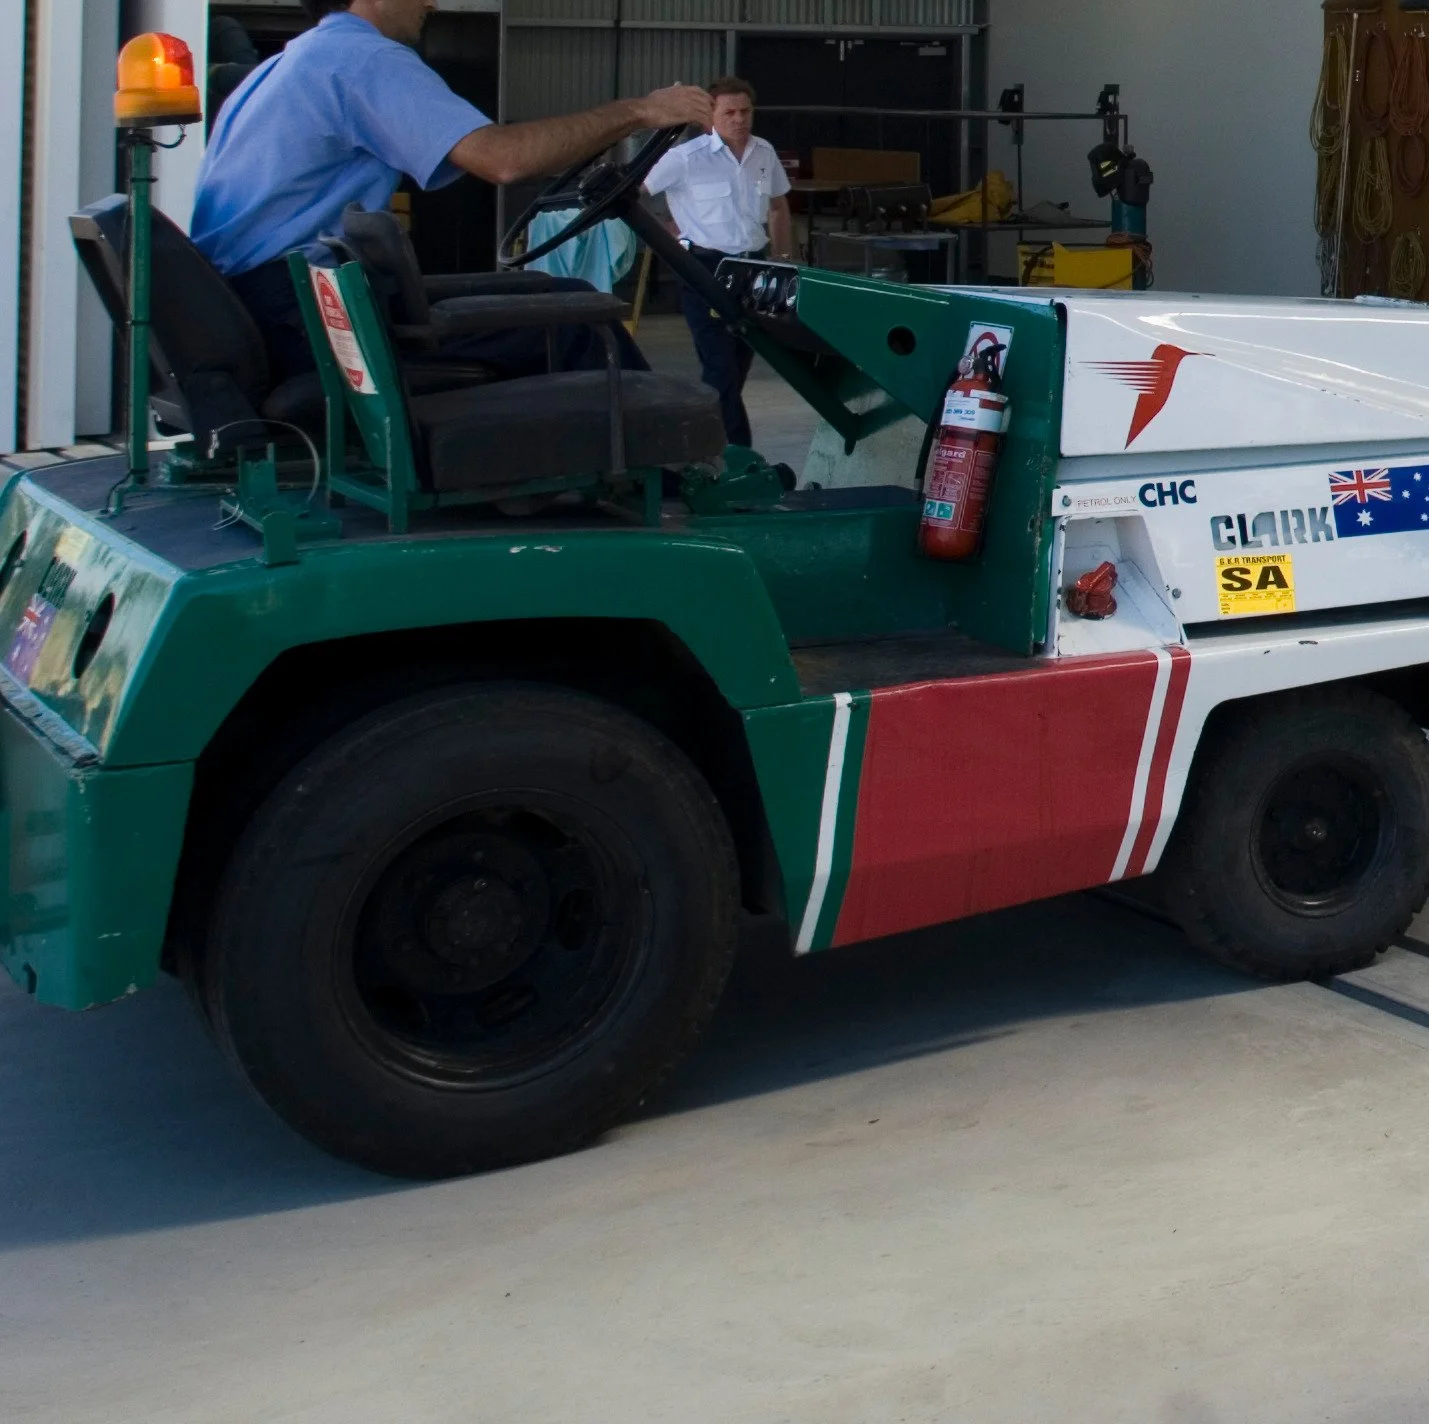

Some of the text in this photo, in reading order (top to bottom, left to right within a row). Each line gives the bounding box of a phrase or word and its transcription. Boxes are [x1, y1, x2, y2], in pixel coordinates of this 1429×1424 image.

[1077, 495, 1137, 509] PETROL ONLY
[1138, 479, 1197, 508] CHC
[1210, 506, 1335, 551] CLARK
[1242, 555, 1287, 565] TRANSPORT
[1221, 566, 1290, 592] SA
